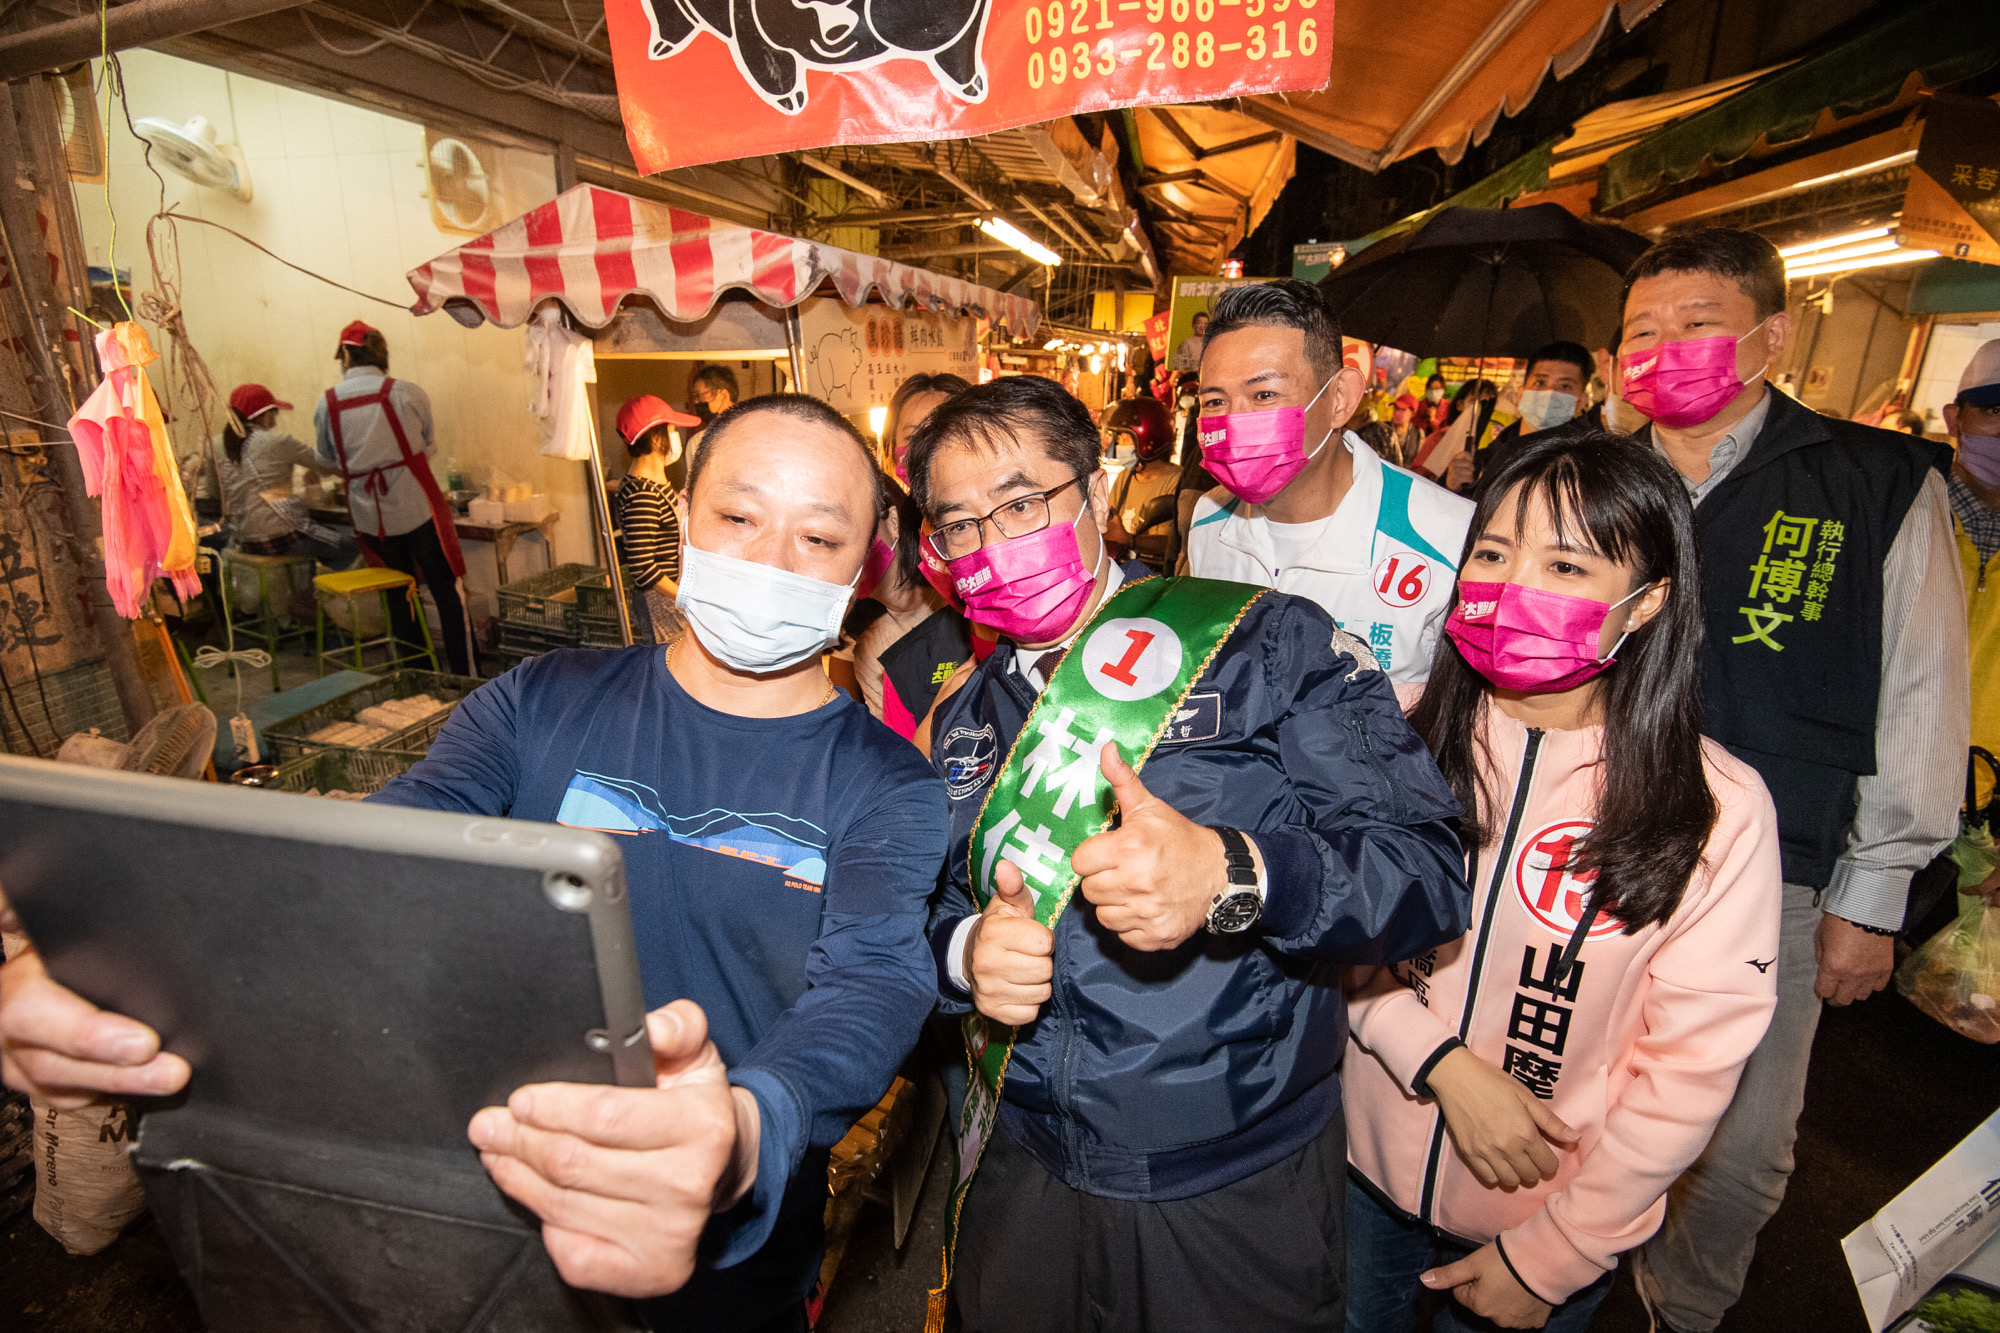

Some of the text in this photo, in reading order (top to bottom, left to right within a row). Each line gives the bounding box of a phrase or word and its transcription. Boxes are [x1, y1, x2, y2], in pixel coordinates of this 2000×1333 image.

[1026, 0, 1316, 44] 0921-966-
[1028, 18, 1317, 89] 0933-288-316
[1379, 557, 1427, 601] 16
[1731, 510, 1819, 652] 何博文
[1800, 519, 1845, 621] 執行總幹事
[1100, 629, 1155, 687] 1
[981, 706, 1115, 904] 林佳
[45, 1131, 60, 1187] Moreno
